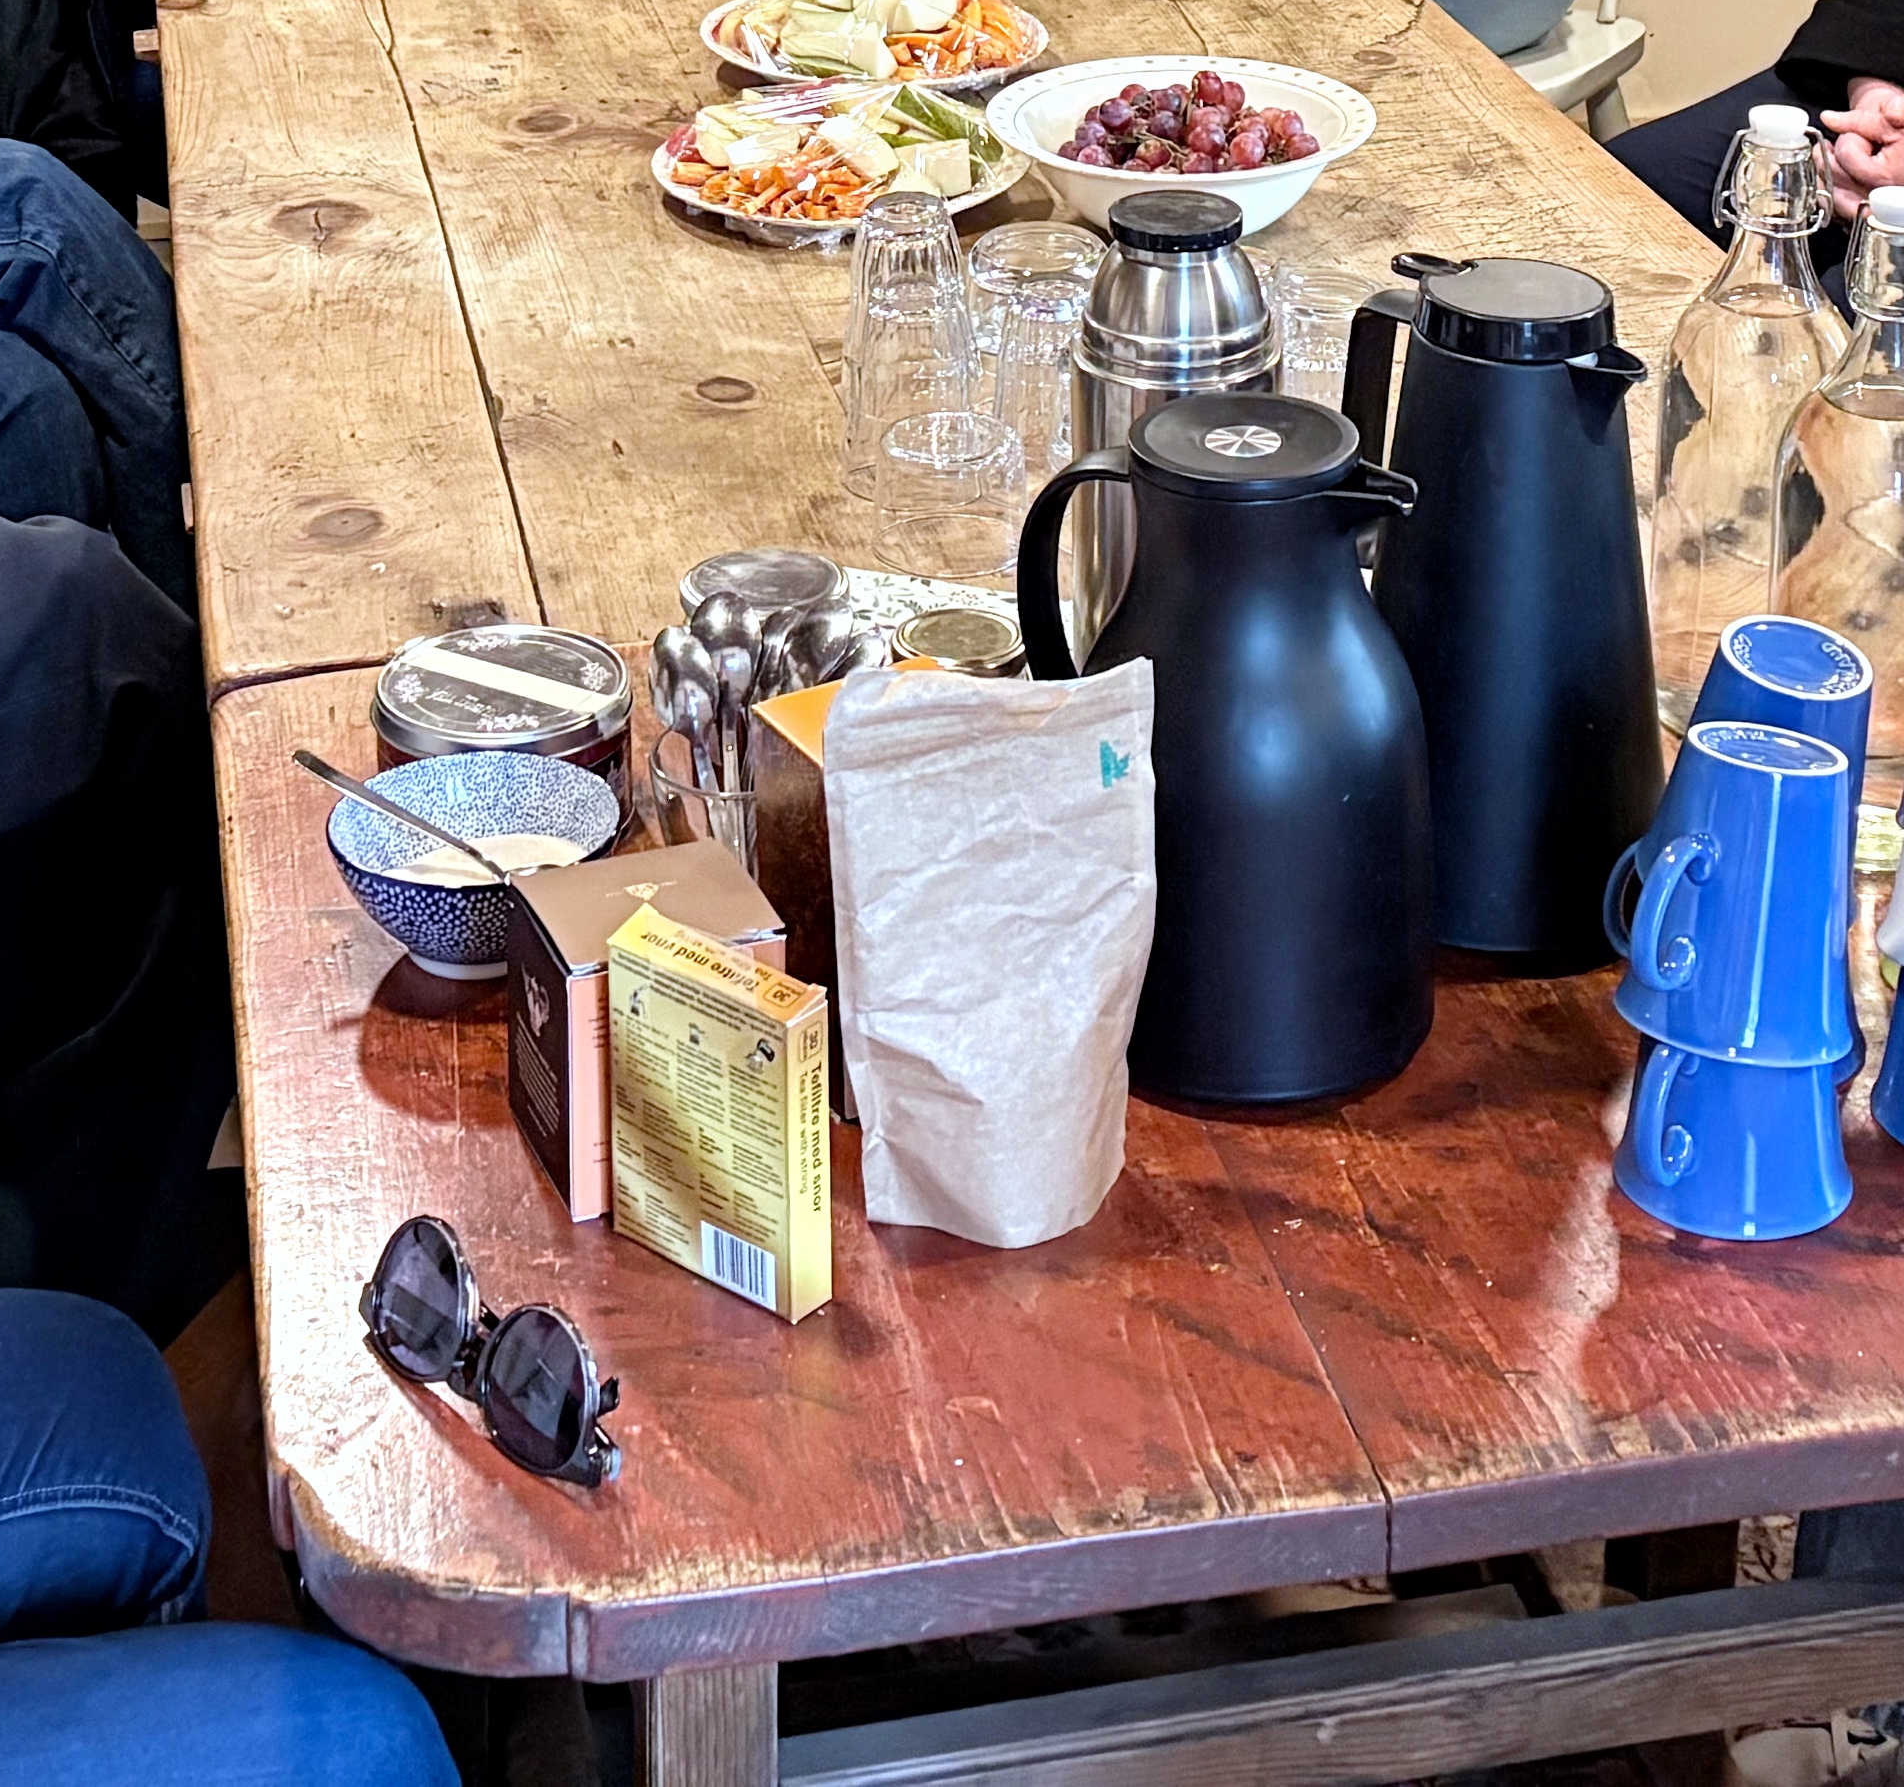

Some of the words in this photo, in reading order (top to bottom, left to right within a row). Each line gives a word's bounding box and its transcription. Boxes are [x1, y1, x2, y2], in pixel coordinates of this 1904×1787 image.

[799, 1071, 809, 1093] Tea
[810, 1061, 823, 1126] Tefiltre
[799, 1129, 809, 1155] with
[811, 1130, 824, 1169] med
[812, 1173, 823, 1212] snor
